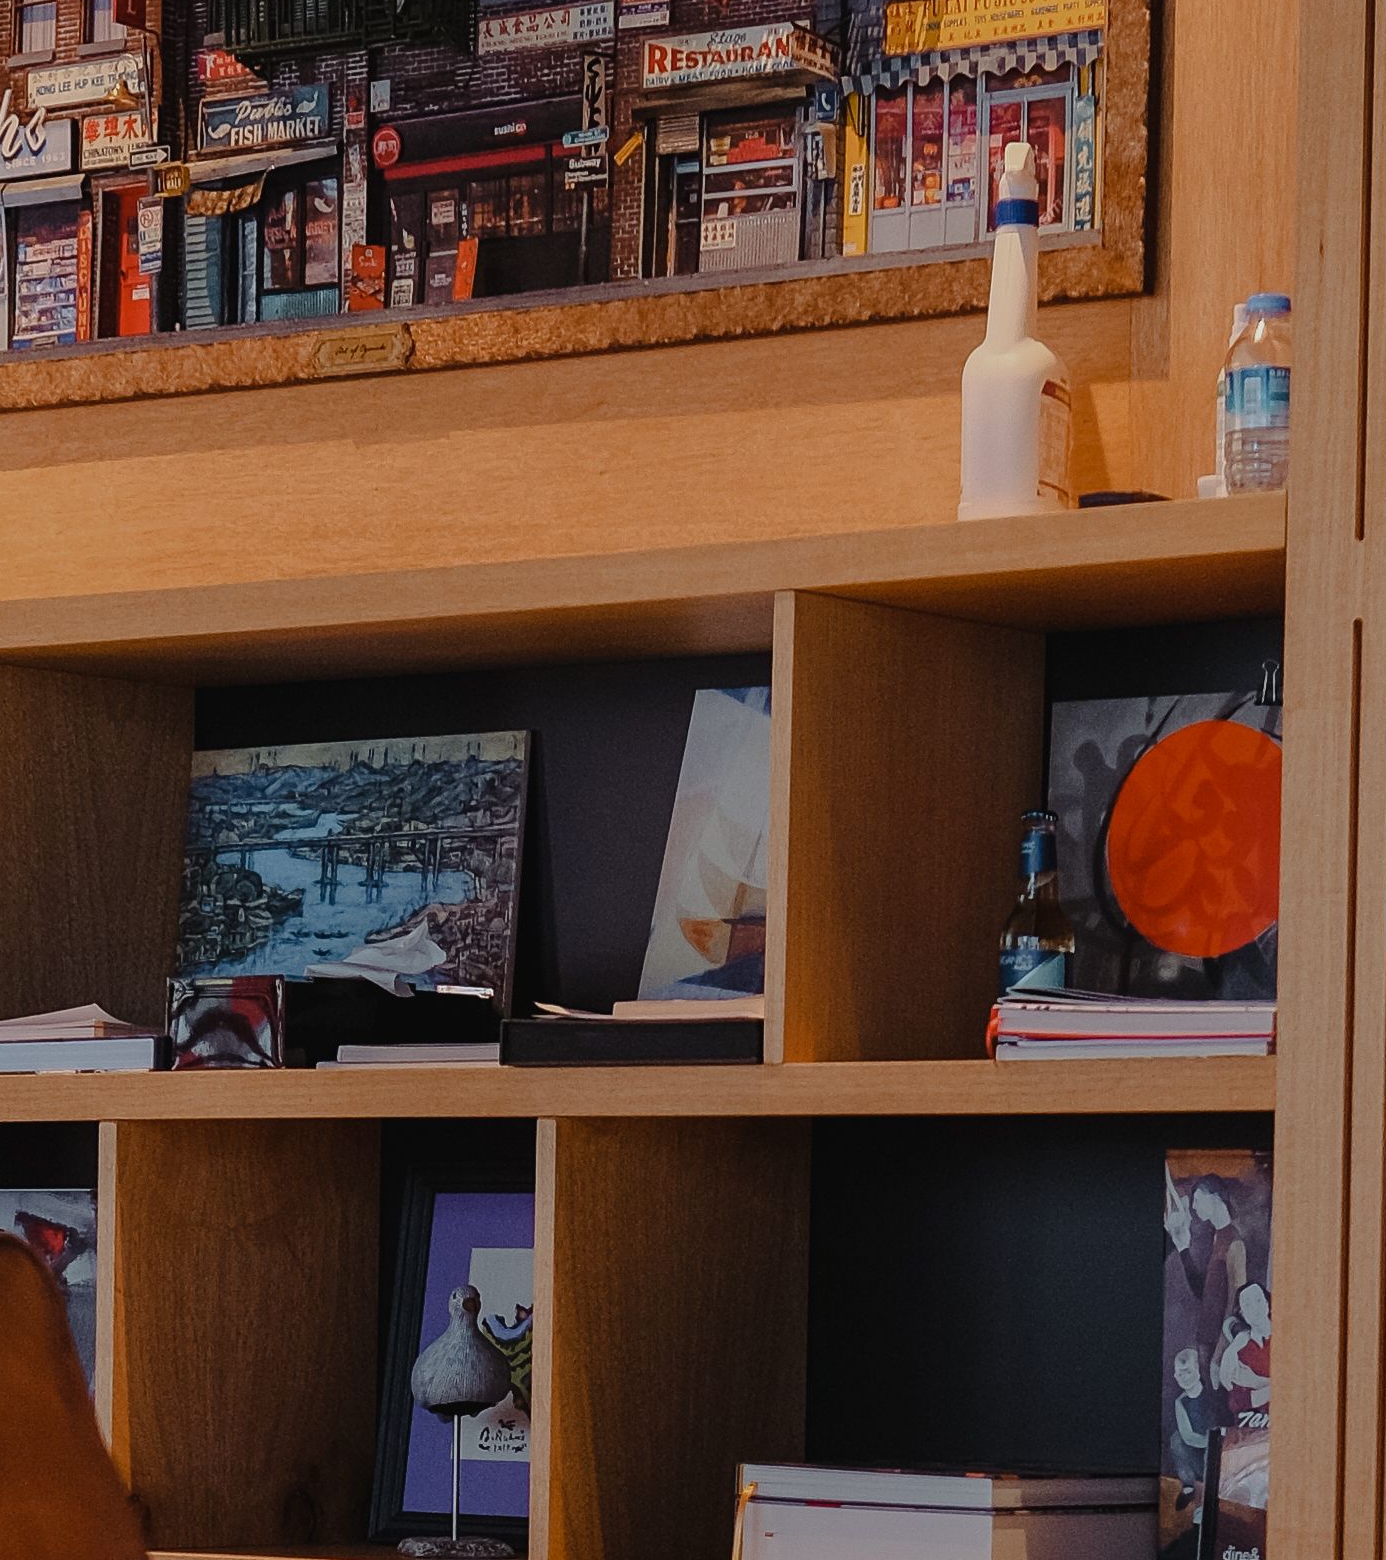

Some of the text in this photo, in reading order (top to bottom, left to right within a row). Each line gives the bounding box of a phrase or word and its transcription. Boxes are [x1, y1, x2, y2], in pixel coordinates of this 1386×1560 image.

[647, 37, 791, 74] RESTAURAN
[230, 116, 321, 147] FISH MARKET
[77, 226, 91, 340] DISCUNT
